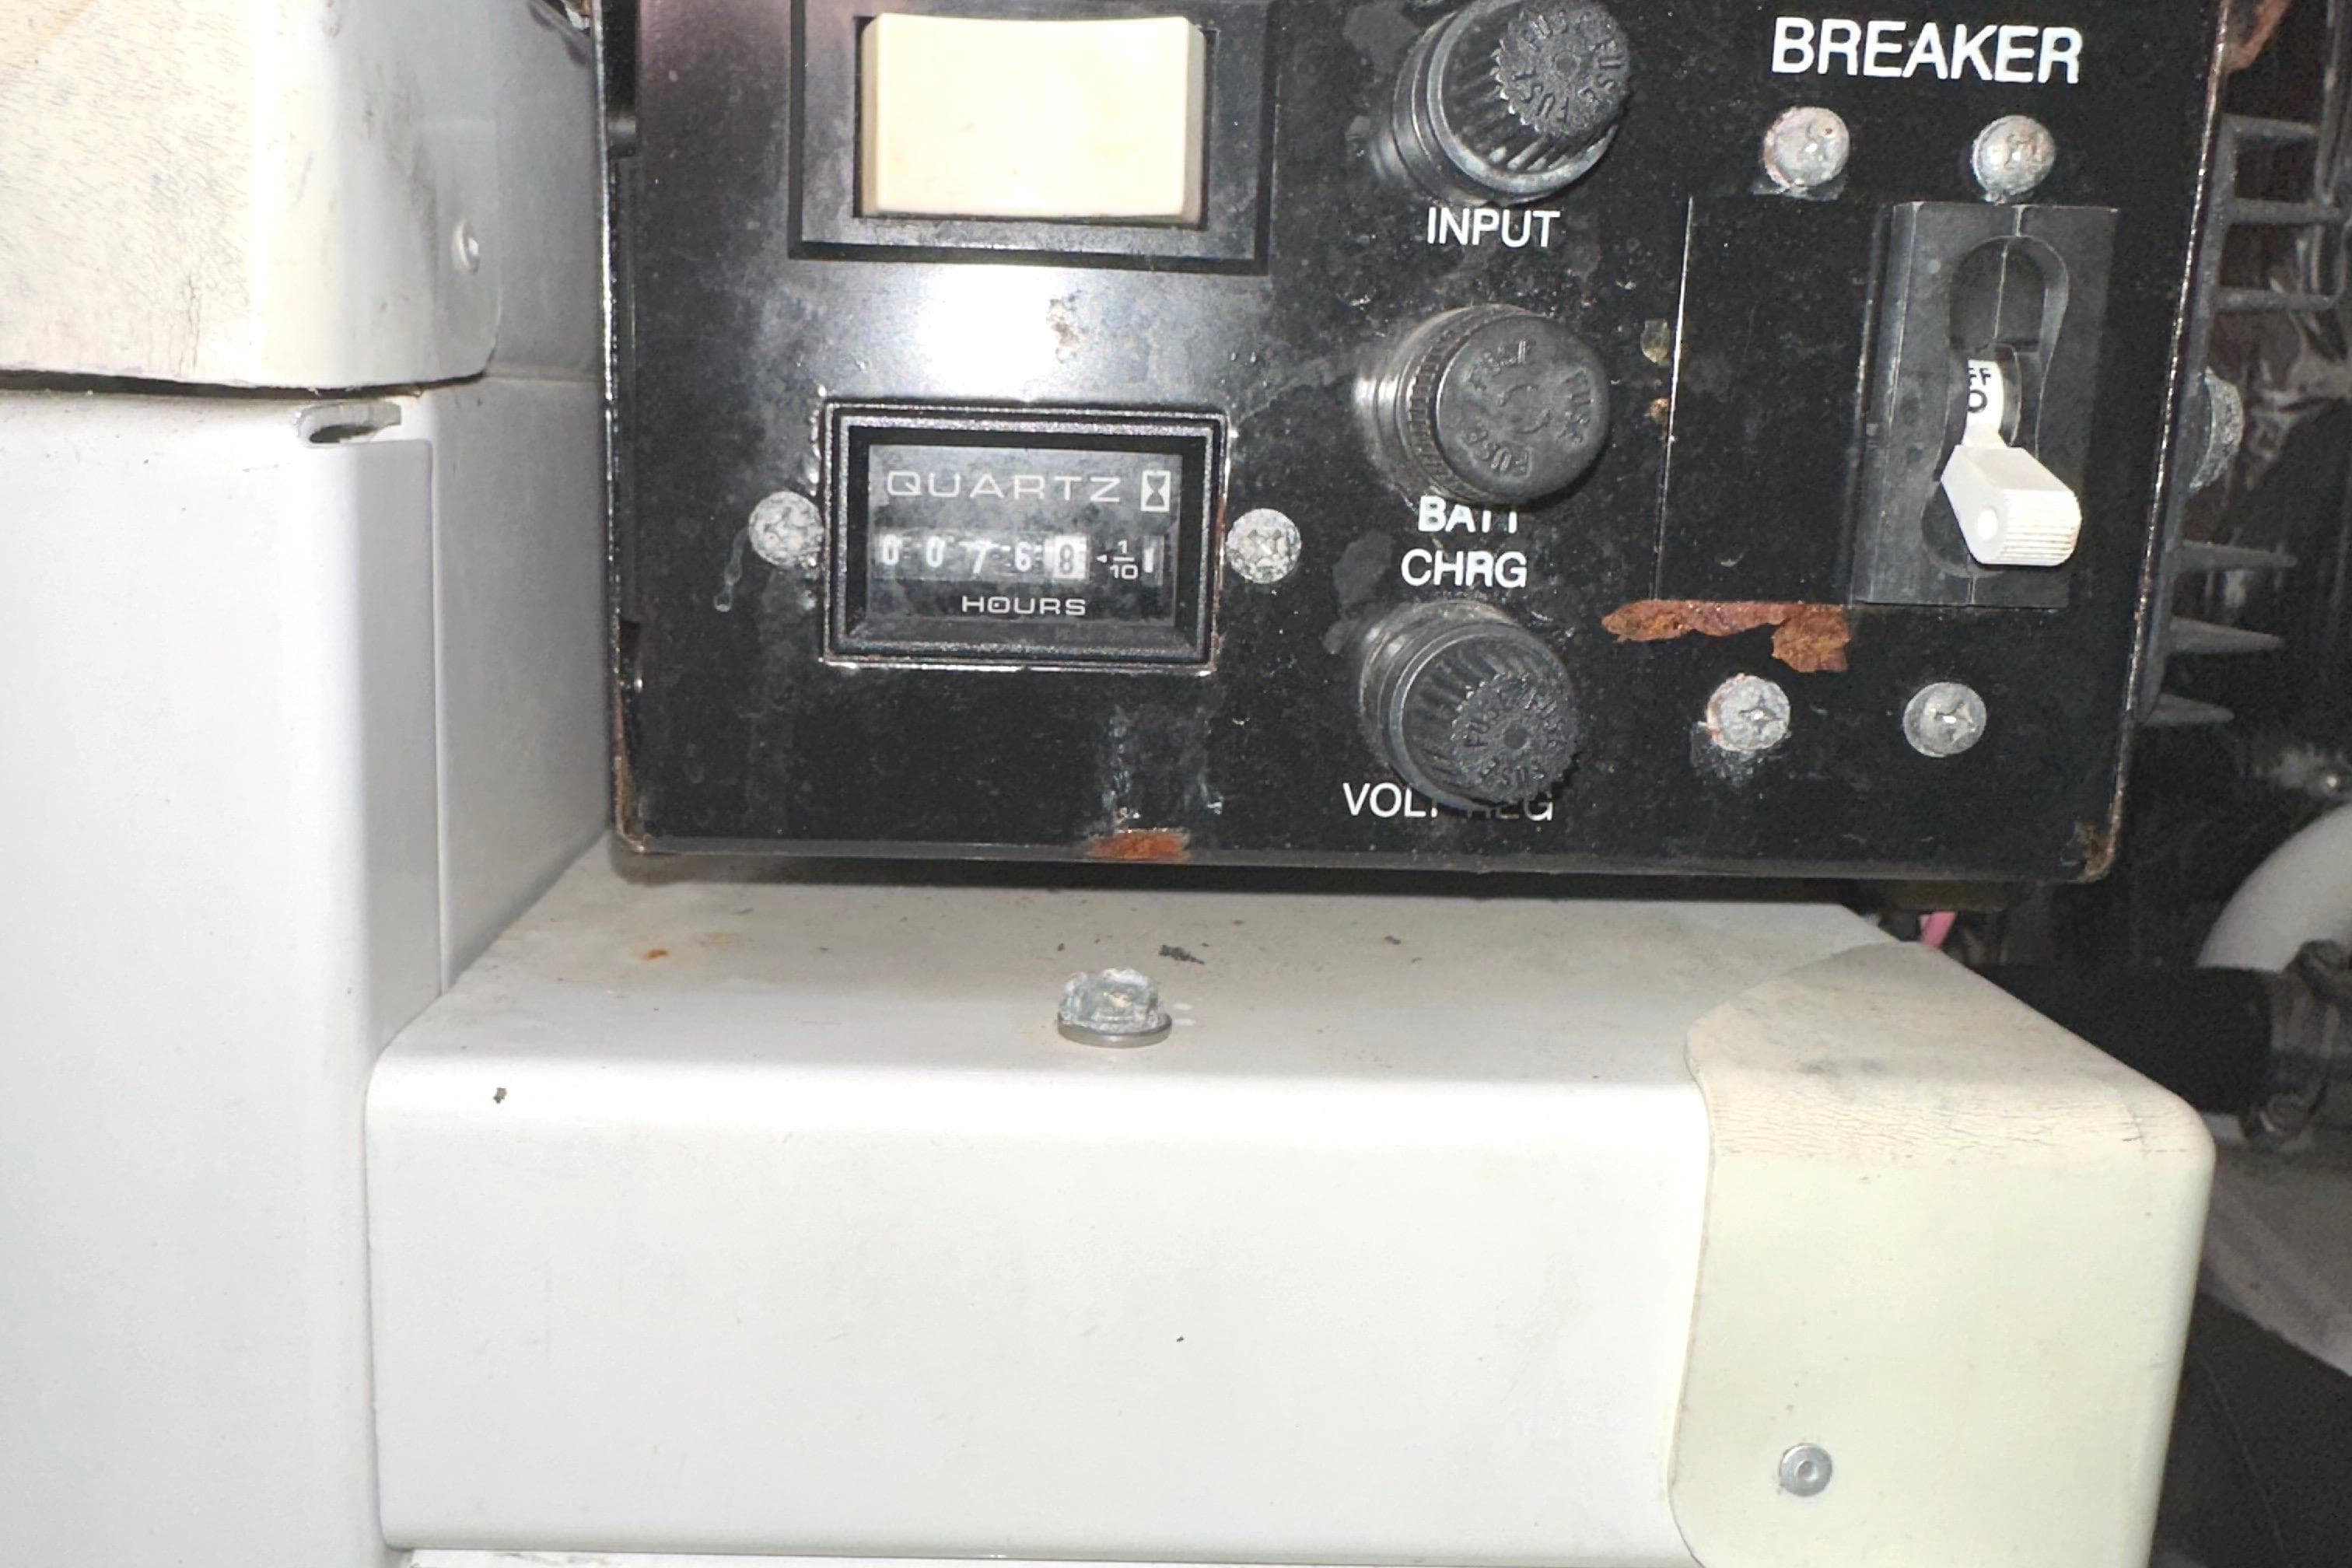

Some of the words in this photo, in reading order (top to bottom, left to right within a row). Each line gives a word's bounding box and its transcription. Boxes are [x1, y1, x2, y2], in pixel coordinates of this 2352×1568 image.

[1772, 16, 2083, 84] BREAKER
[1427, 207, 1561, 247] INPUT
[886, 470, 1122, 503] QUARTZ
[1401, 548, 1527, 589] CHRG
[961, 595, 1087, 617] HOURS
[1342, 782, 1438, 818] VOL
